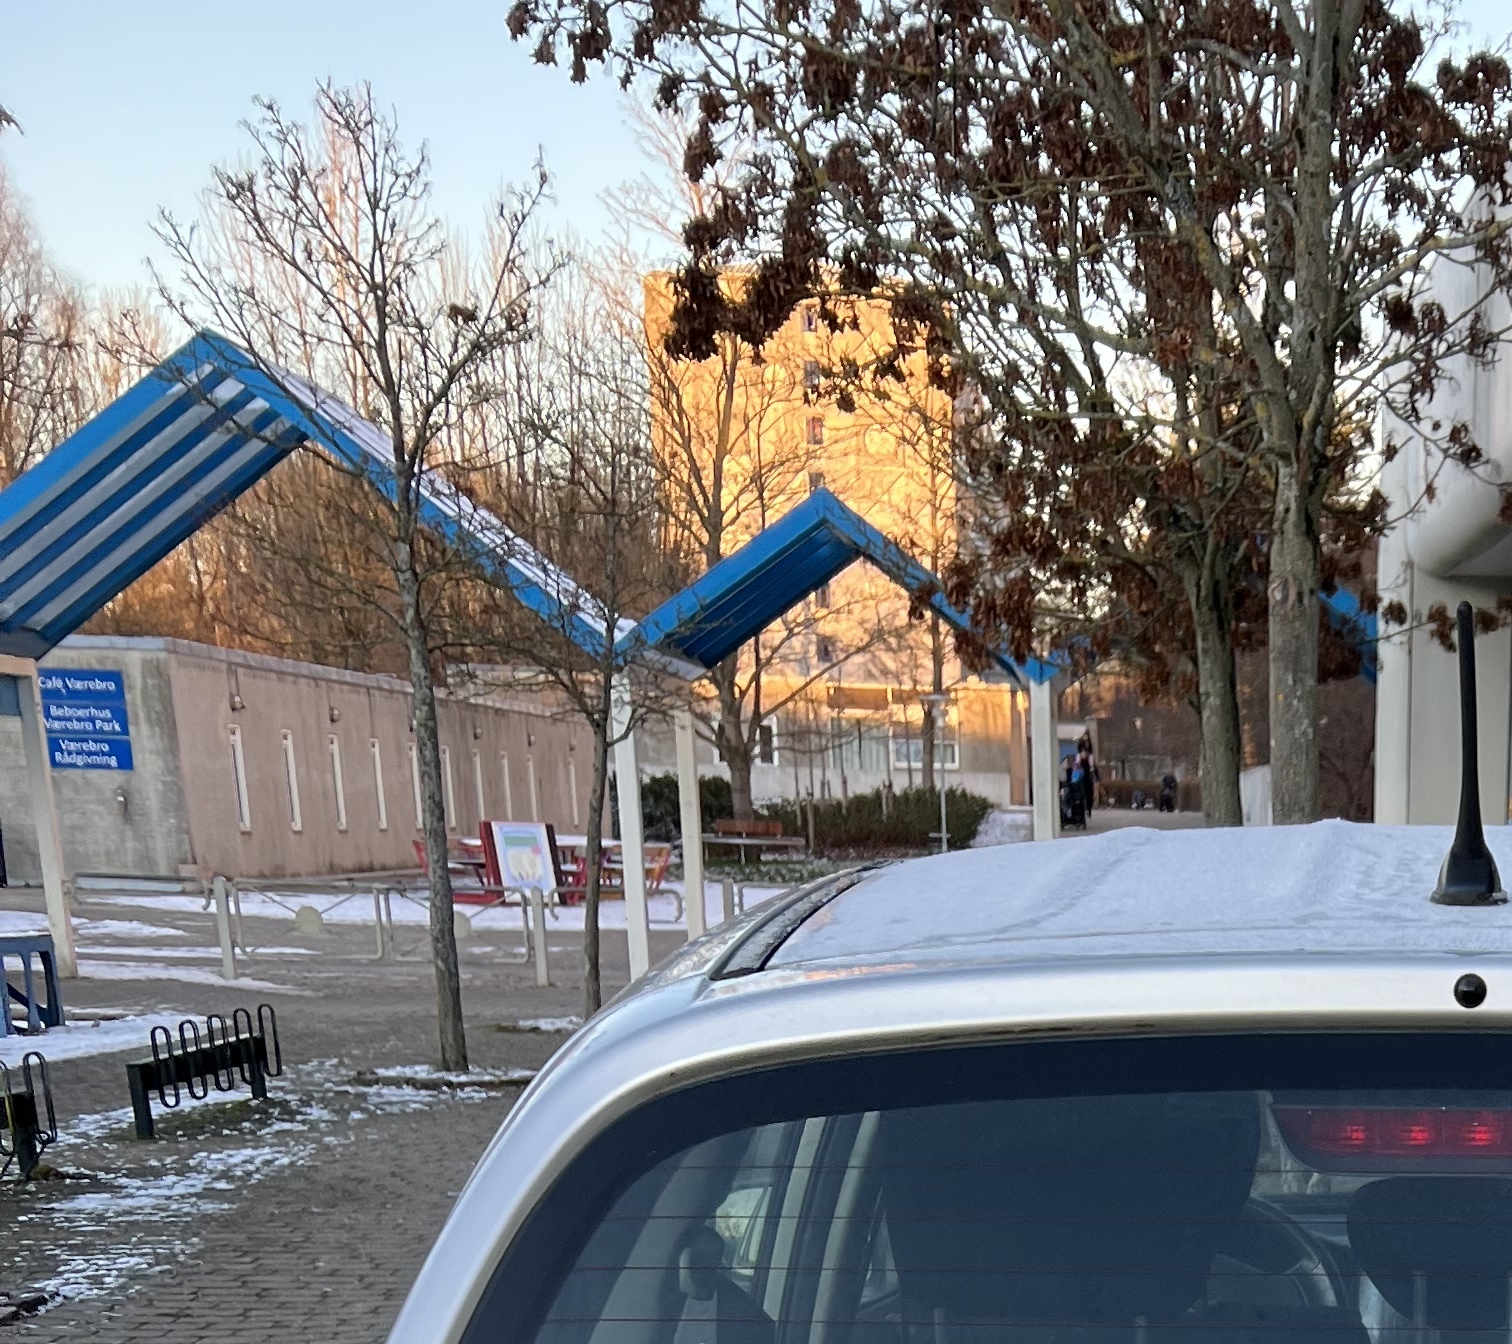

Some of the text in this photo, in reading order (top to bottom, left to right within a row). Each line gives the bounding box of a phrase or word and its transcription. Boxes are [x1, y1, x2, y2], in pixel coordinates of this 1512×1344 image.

[65, 677, 116, 691] Værebro
[49, 704, 112, 718] Beboerhus
[43, 718, 121, 732] Værebro Park
[59, 739, 110, 752] Værebro
[54, 752, 118, 767] Rådgivning
